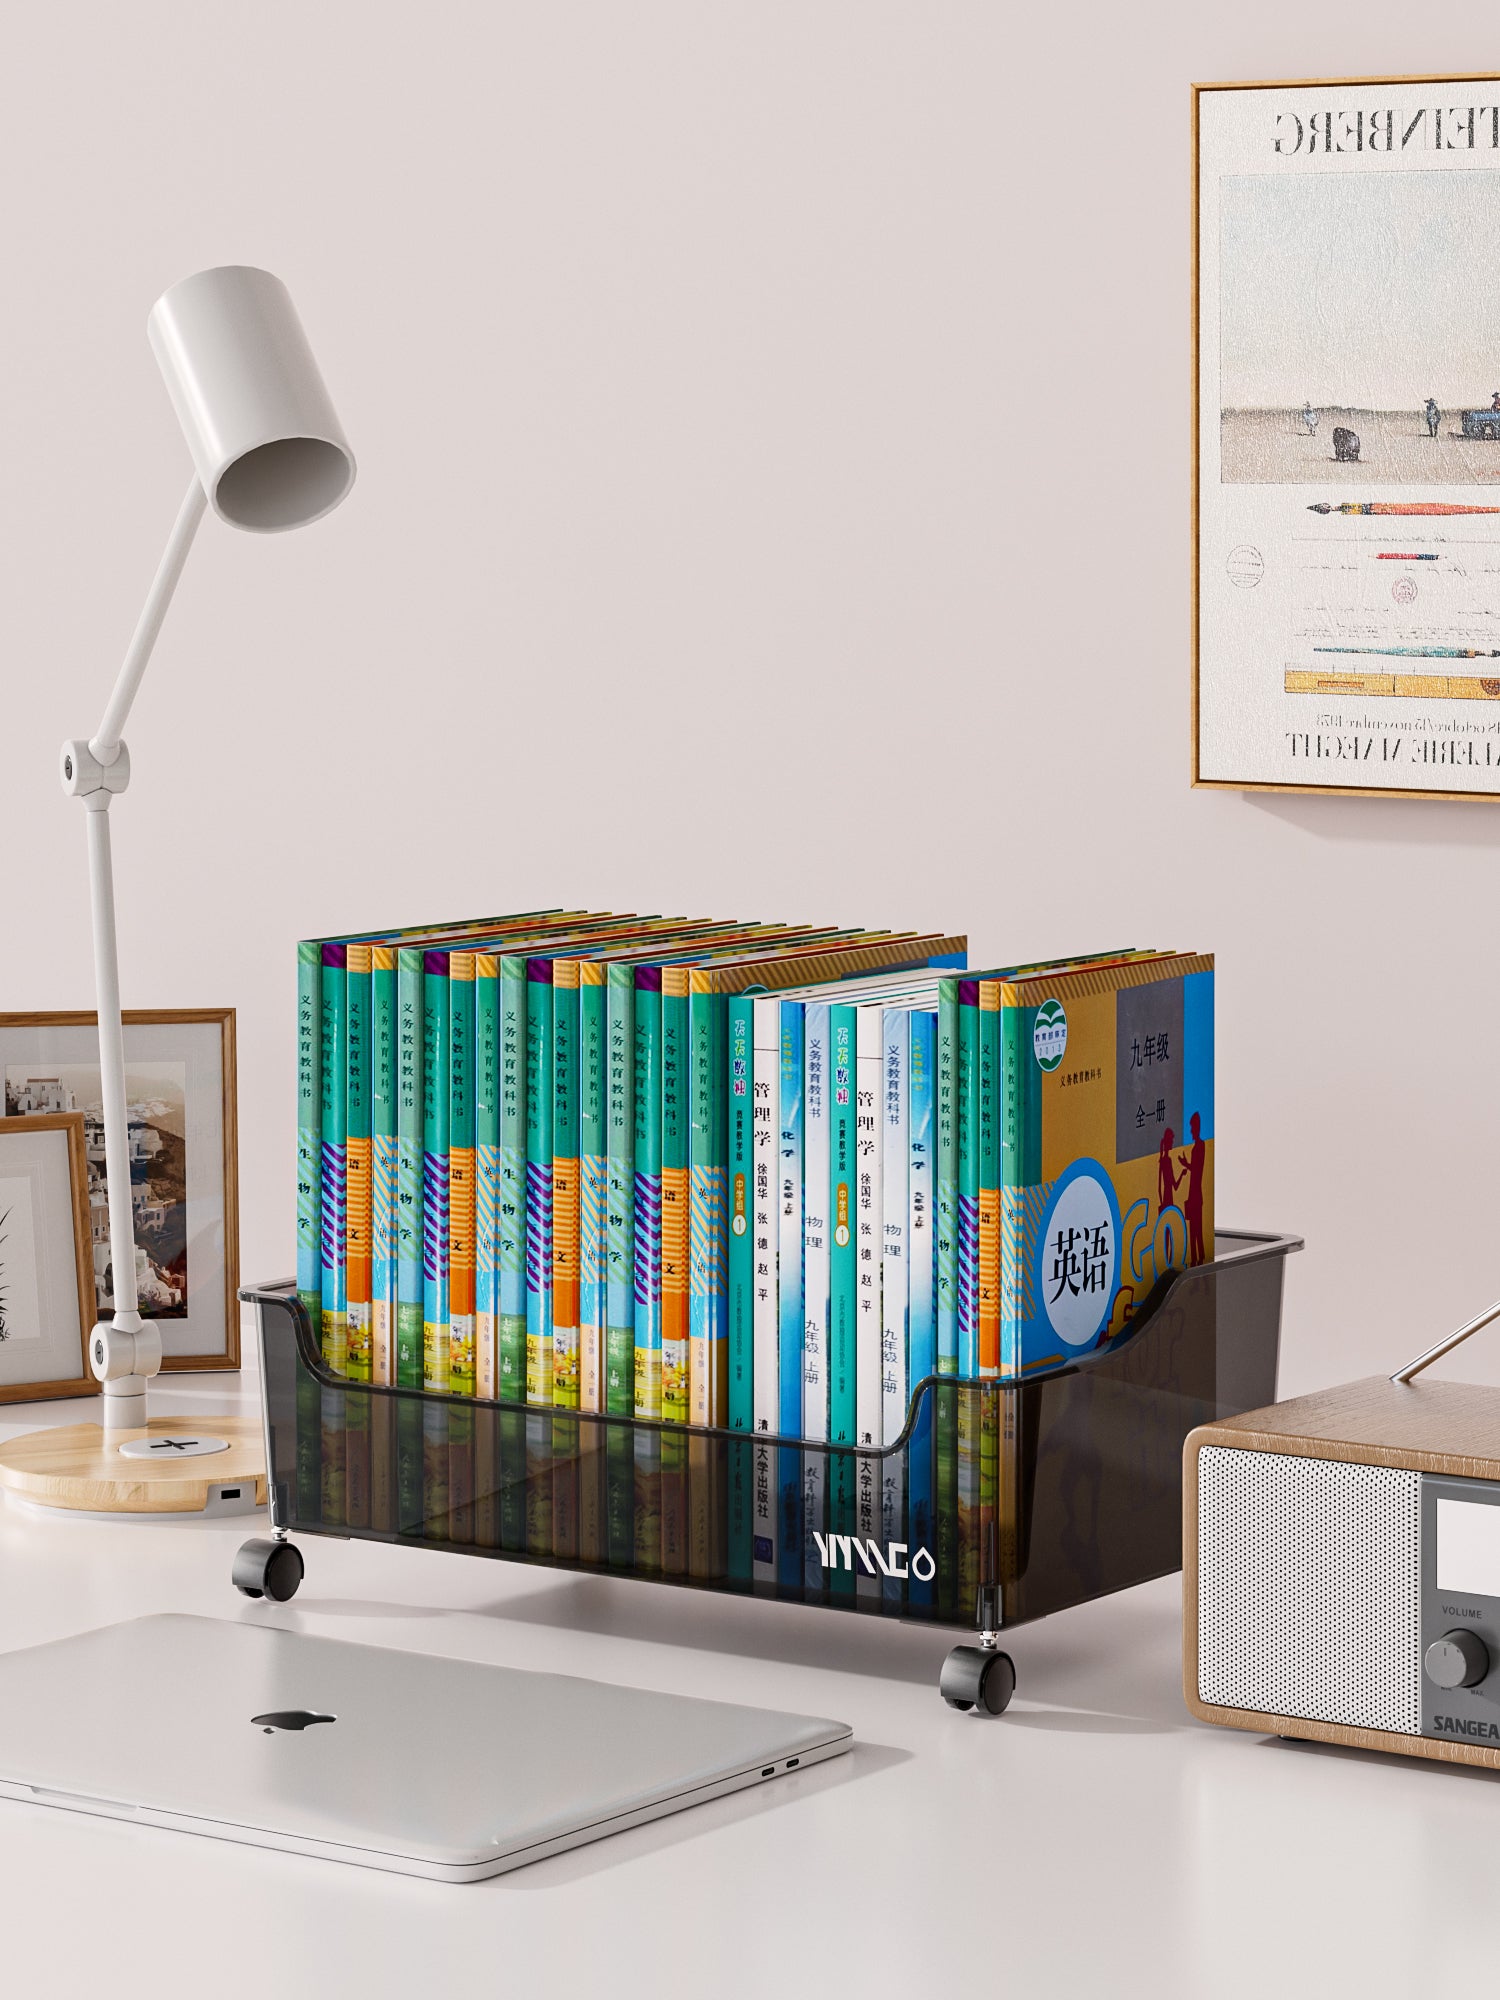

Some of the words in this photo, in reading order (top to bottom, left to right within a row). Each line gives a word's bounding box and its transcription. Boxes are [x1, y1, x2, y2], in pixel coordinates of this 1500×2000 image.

[300, 994, 312, 1098] 义务教育教科书
[402, 1003, 414, 1107] 义务教育教科书
[505, 1011, 517, 1117] 义务教育教科书
[612, 1019, 625, 1127] 义务教育教科书
[808, 1039, 822, 1118] 义务教育教科书
[1060, 1068, 1102, 1088] 义务教育教科书
[1130, 1033, 1170, 1071] 九年级
[754, 1082, 771, 1146] 管理学
[886, 1046, 900, 1125] 义务教育教科书
[941, 1036, 951, 1147] 义务教育教科书
[1136, 1099, 1166, 1129] 全一册
[781, 1131, 795, 1158] 化学
[858, 1091, 875, 1156] 管理学
[298, 1148, 311, 1229] 生物学
[911, 1143, 925, 1170] 化学
[400, 1158, 414, 1239] 生物学
[502, 1169, 515, 1250] 生物学
[609, 1179, 623, 1262] 生物学
[805, 1215, 823, 1249] 物理
[884, 1224, 901, 1257] 物理
[939, 1203, 950, 1289] 生物学
[1048, 1220, 1110, 1305] 英语
[805, 1320, 819, 1355] 九年级
[883, 1329, 898, 1364] 九年级
[805, 1361, 819, 1384] 上册
[883, 1371, 897, 1394] 上册
[1442, 1605, 1482, 1619] VOLUME
